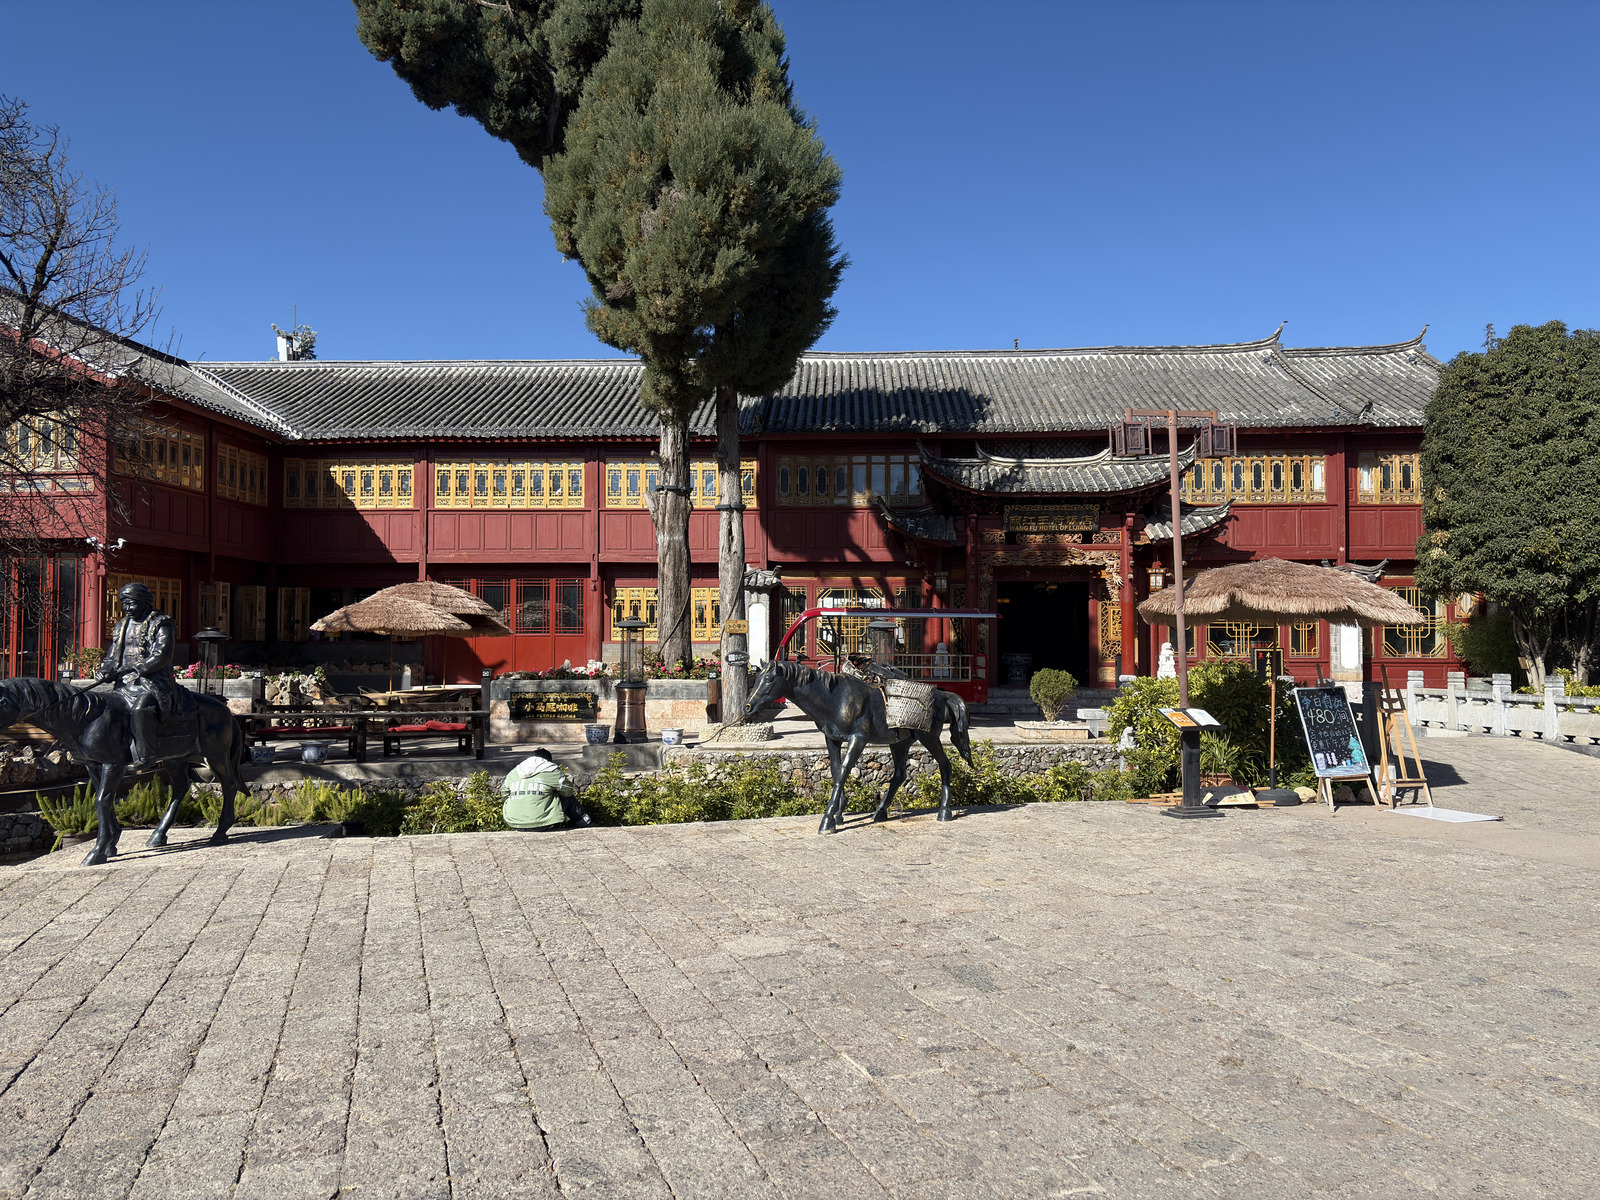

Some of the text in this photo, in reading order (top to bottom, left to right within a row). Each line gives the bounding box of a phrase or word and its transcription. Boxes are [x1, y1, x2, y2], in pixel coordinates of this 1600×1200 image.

[524, 701, 579, 713] 小马厩咖啡
[1301, 693, 1343, 710] 今日有房
